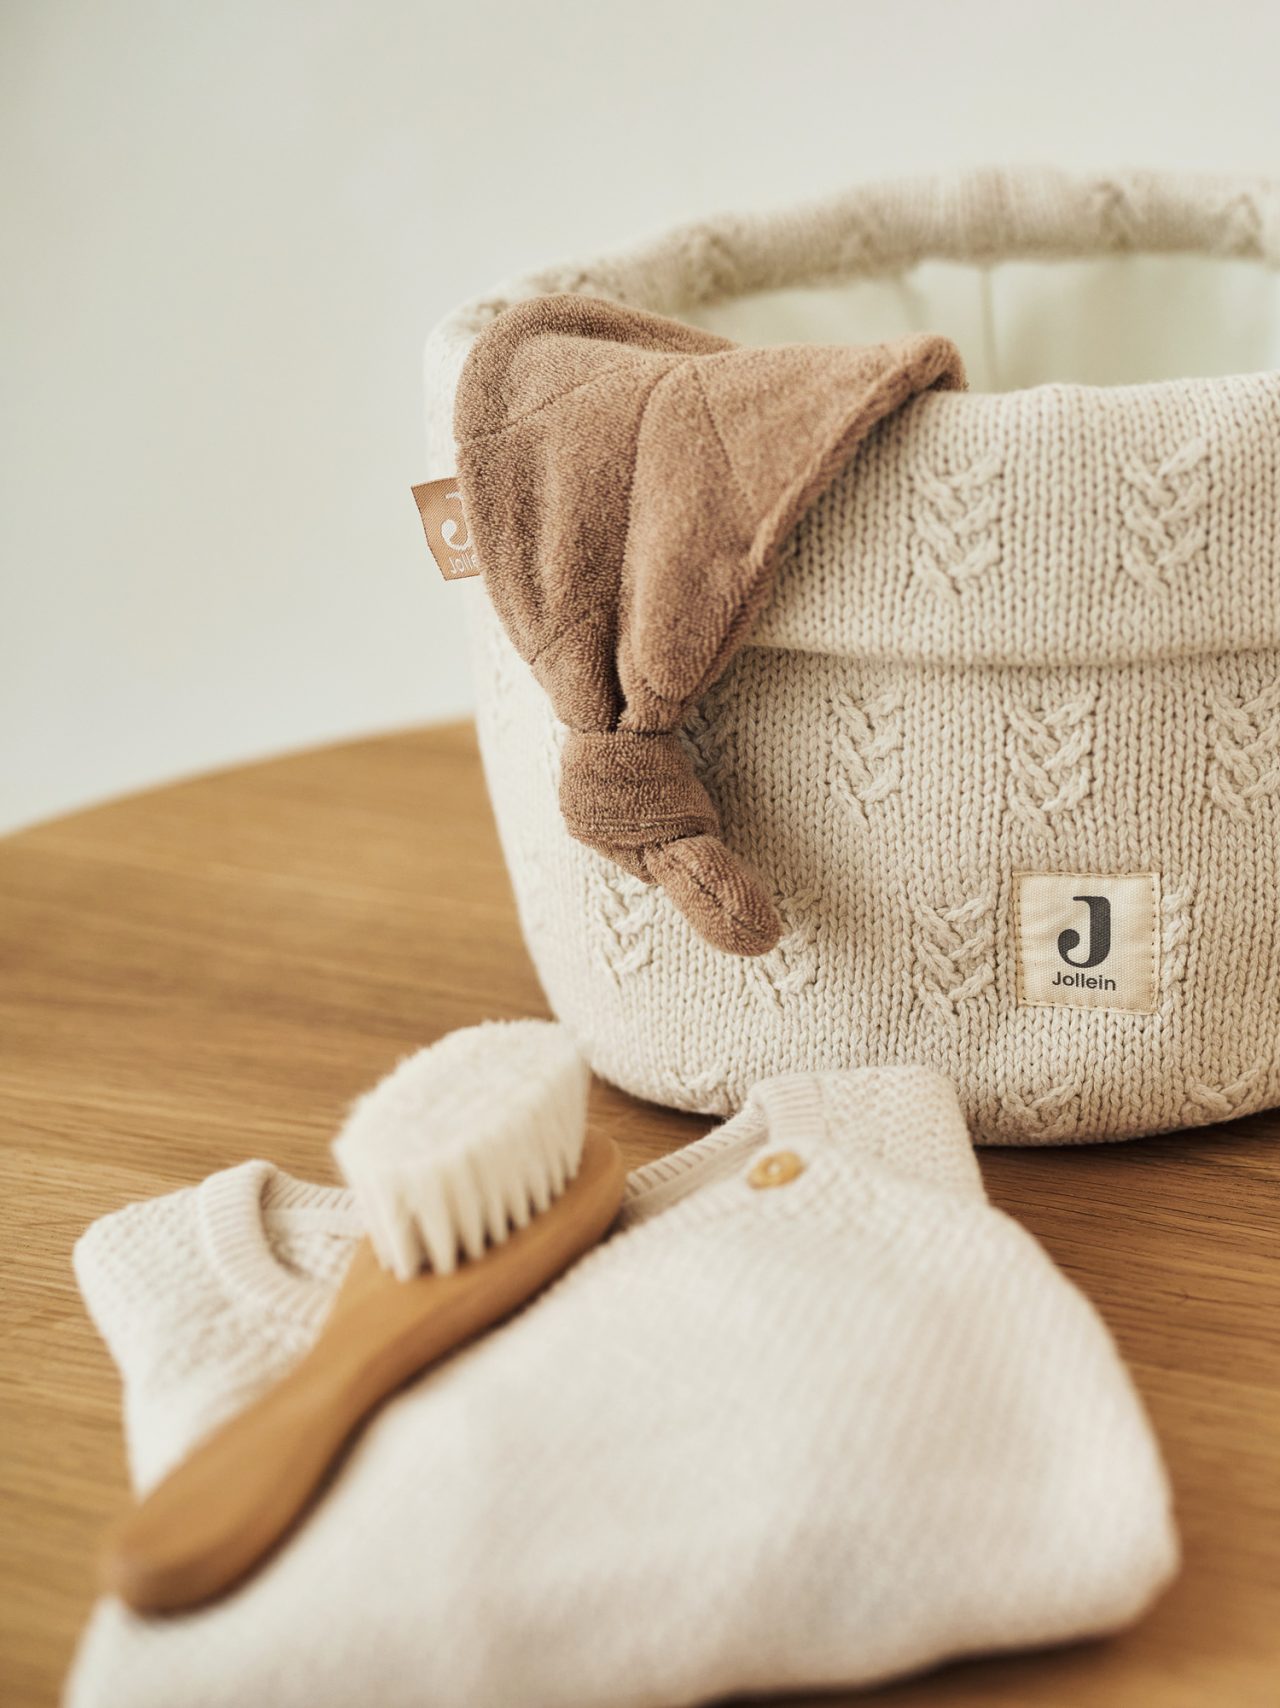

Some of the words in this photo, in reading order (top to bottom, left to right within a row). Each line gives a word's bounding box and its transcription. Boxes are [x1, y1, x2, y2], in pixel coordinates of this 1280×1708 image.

[441, 491, 474, 551] J
[449, 552, 480, 575] Jolle
[1058, 895, 1111, 969] J
[1051, 971, 1117, 991] Jollein
